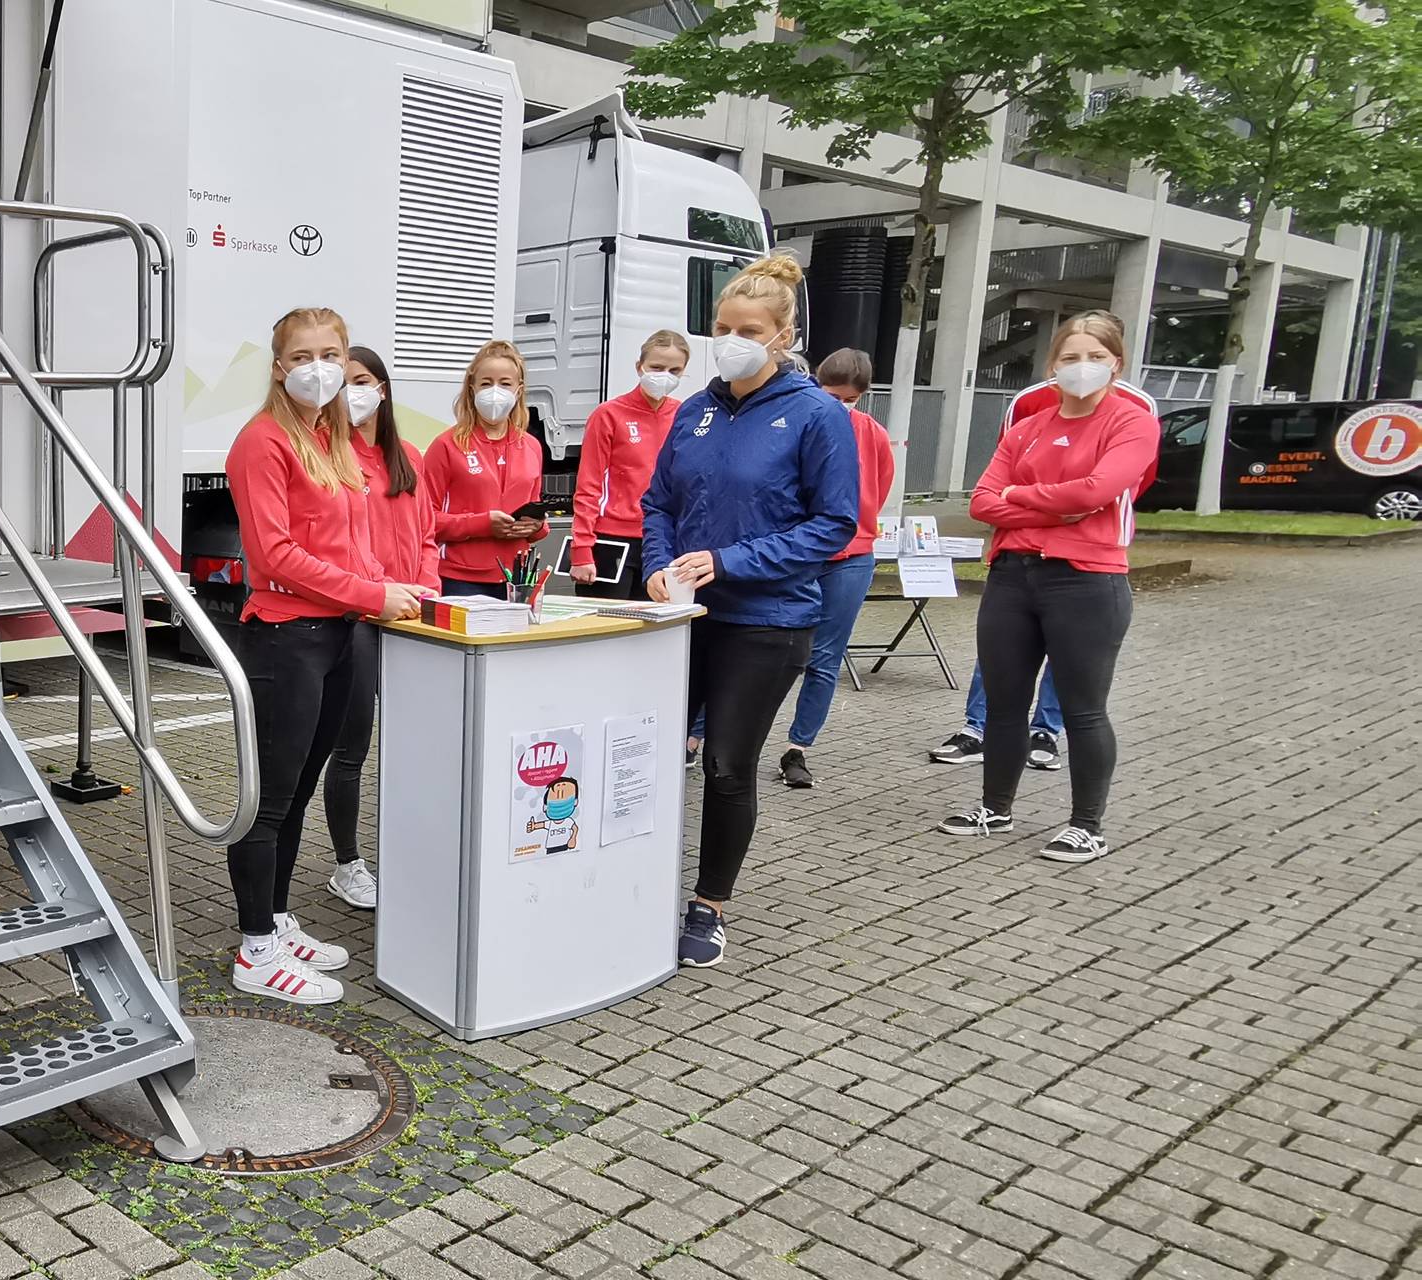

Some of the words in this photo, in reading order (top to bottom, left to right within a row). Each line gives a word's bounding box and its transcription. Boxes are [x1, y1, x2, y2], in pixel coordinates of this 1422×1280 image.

[189, 189, 202, 201] Top
[203, 191, 231, 203] Partner
[230, 237, 278, 253] Sparkasse
[1363, 418, 1406, 460] b
[1279, 451, 1327, 461] EVENT.
[1240, 475, 1298, 484] MACHEN.
[518, 743, 566, 771] AHA
